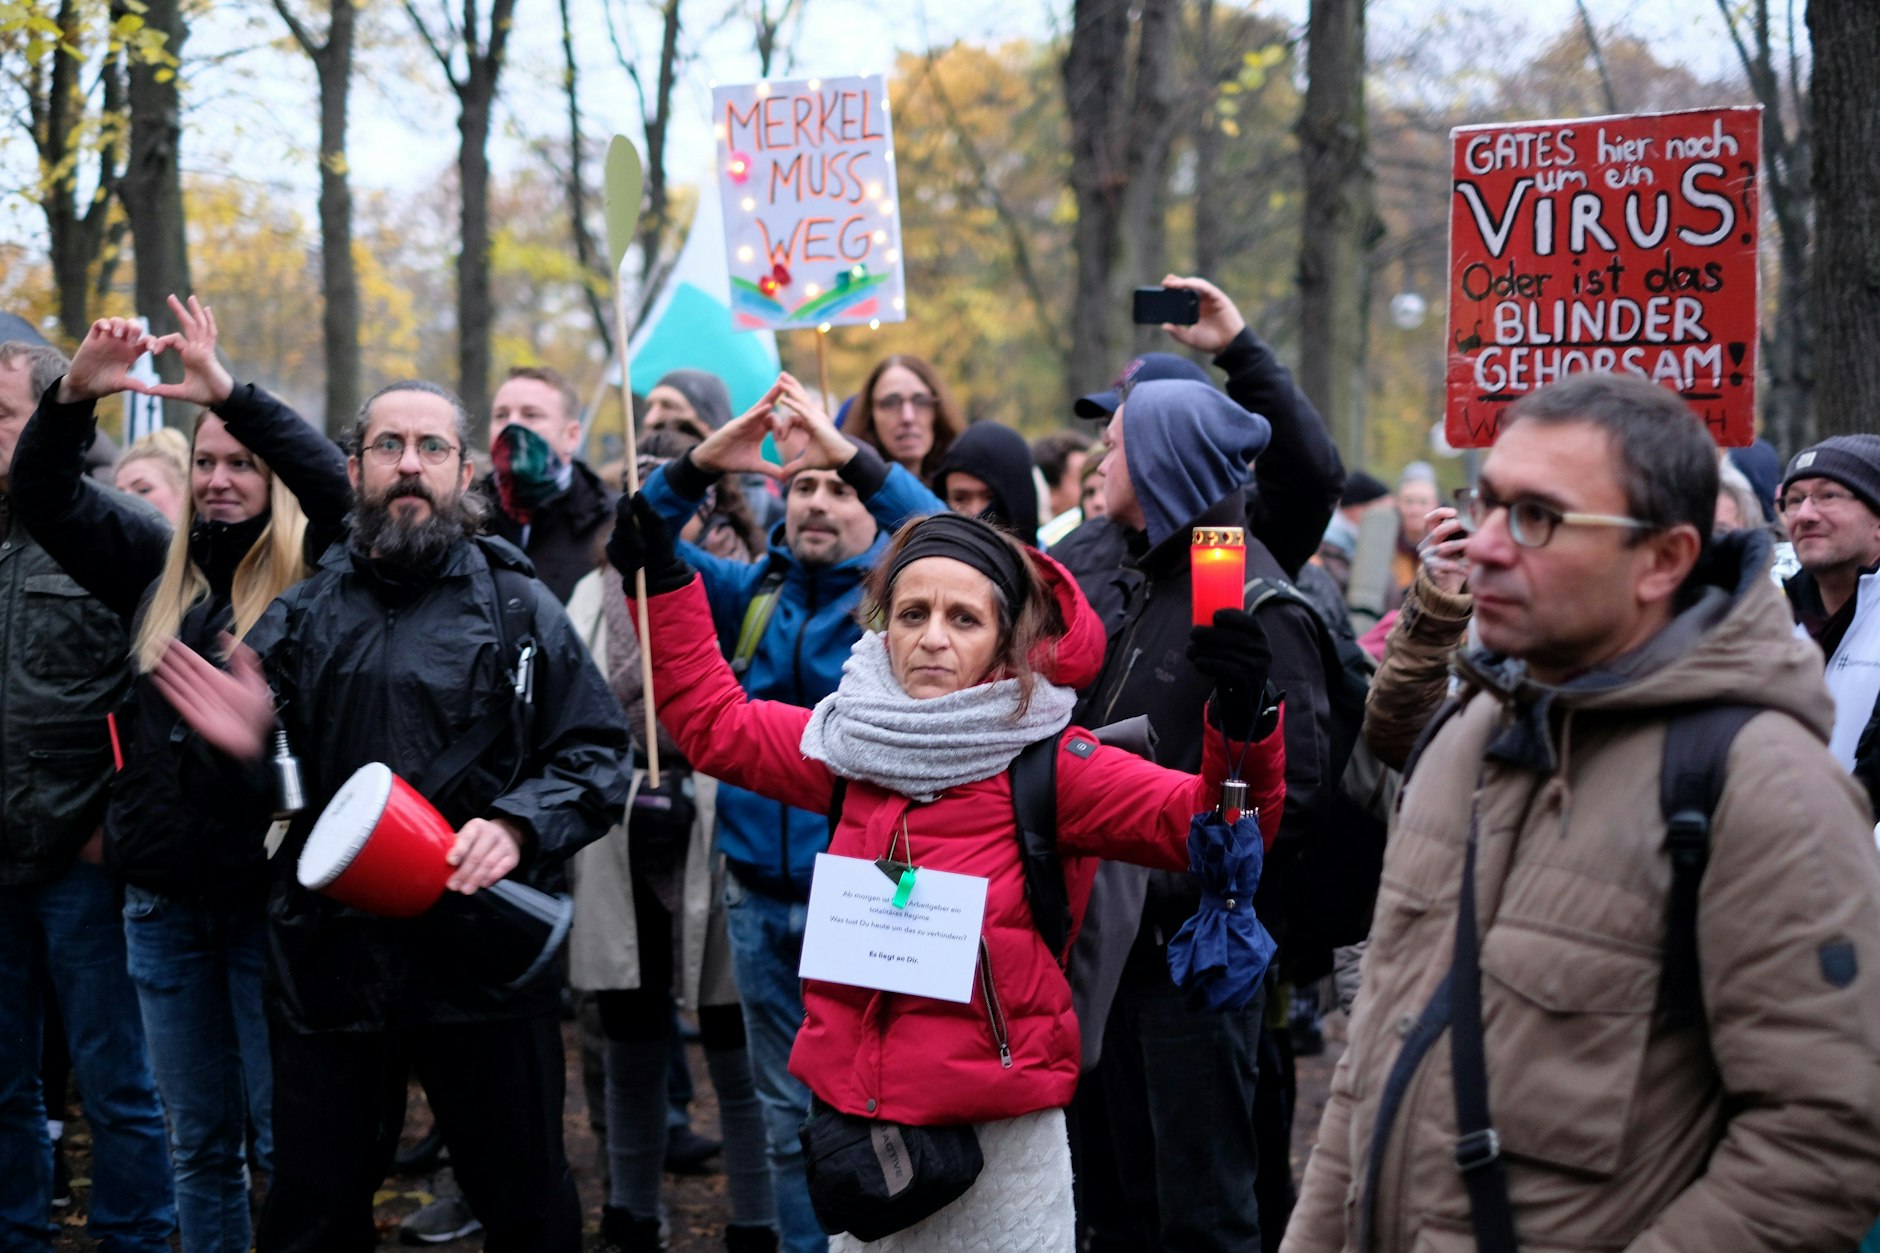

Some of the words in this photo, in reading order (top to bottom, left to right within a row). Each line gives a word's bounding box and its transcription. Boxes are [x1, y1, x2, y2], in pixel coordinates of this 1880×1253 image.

[726, 90, 883, 151] MERKEL
[1465, 129, 1576, 175] GATES
[1597, 127, 1654, 164] hier
[1665, 118, 1739, 161] noch
[769, 151, 870, 205] MUSS
[1534, 170, 1588, 193] um
[1605, 163, 1654, 189] ein
[756, 215, 873, 268] WEG
[1462, 258, 1552, 301] Oder
[1573, 256, 1625, 295] ist
[1645, 248, 1724, 293] das
[1494, 297, 1711, 345] BLINDER
[830, 915, 845, 924] Was
[845, 917, 859, 925] tust
[859, 919, 870, 927] Du
[870, 921, 891, 930] heute
[904, 926, 916, 934] das
[842, 890, 853, 898] Ab
[853, 892, 881, 902] morgen
[908, 900, 950, 912] Arbeitgeber
[869, 950, 878, 958] Es
[878, 951, 896, 961] liegt
[881, 1134, 904, 1178] ACTIVE
